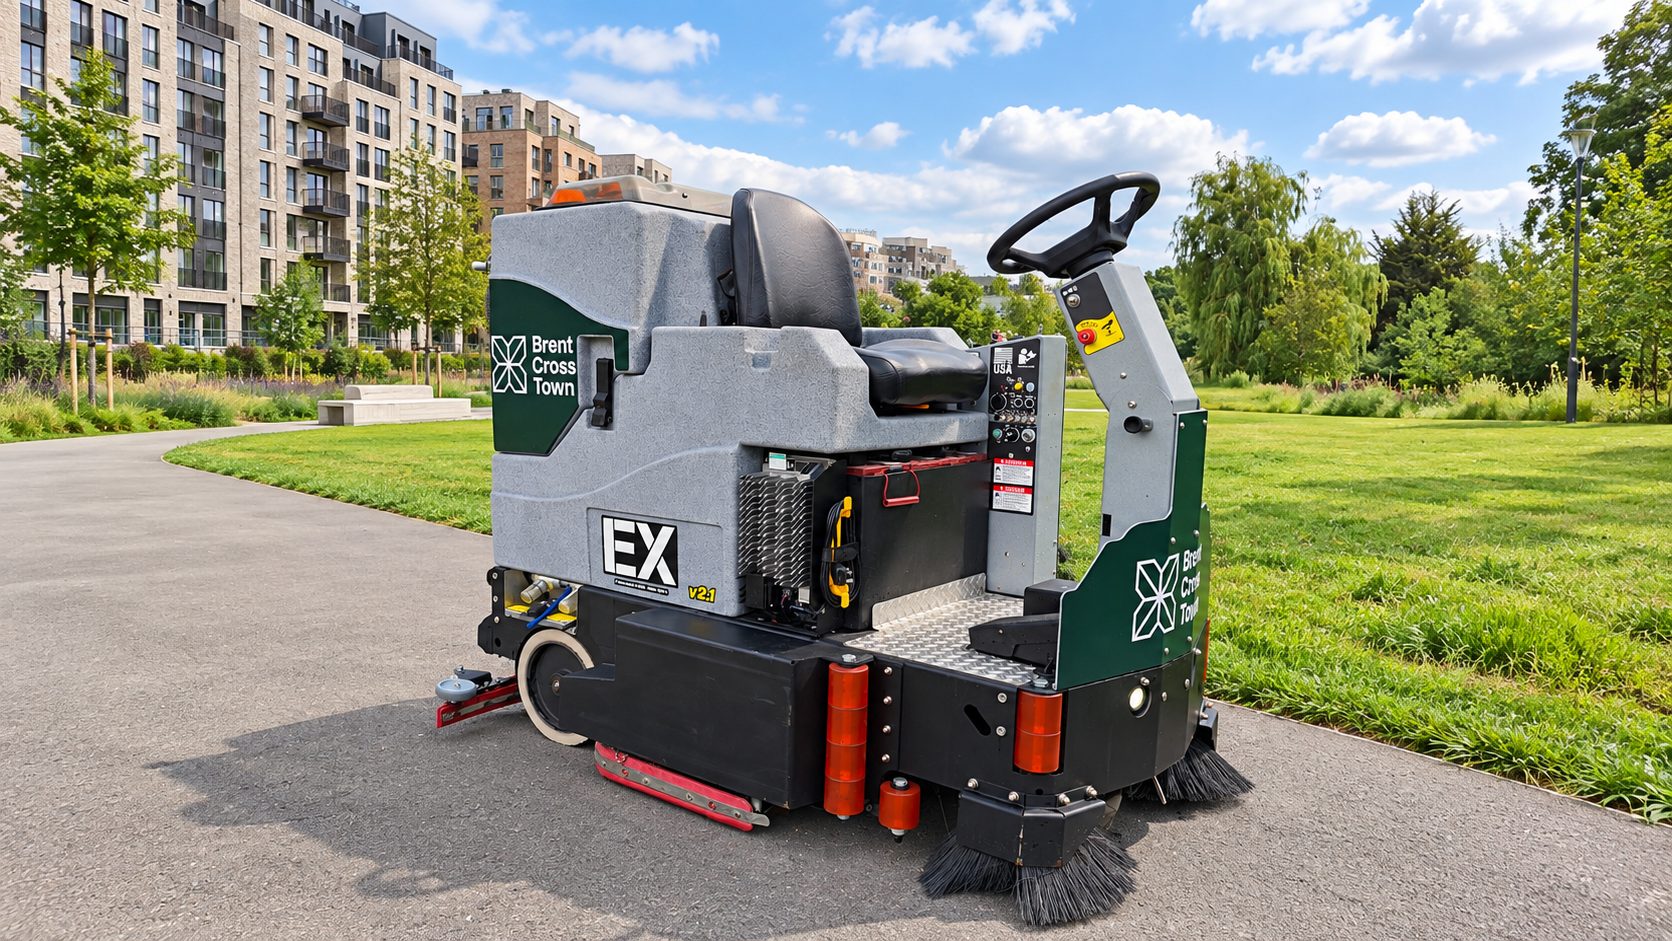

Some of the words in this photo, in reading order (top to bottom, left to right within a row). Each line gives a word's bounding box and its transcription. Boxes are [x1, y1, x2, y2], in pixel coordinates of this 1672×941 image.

[532, 335, 574, 354] Brent
[532, 356, 577, 375] Cross
[993, 363, 1013, 375] USA
[532, 376, 575, 397] Town
[602, 517, 676, 586] EX
[688, 585, 717, 603] v2.1
